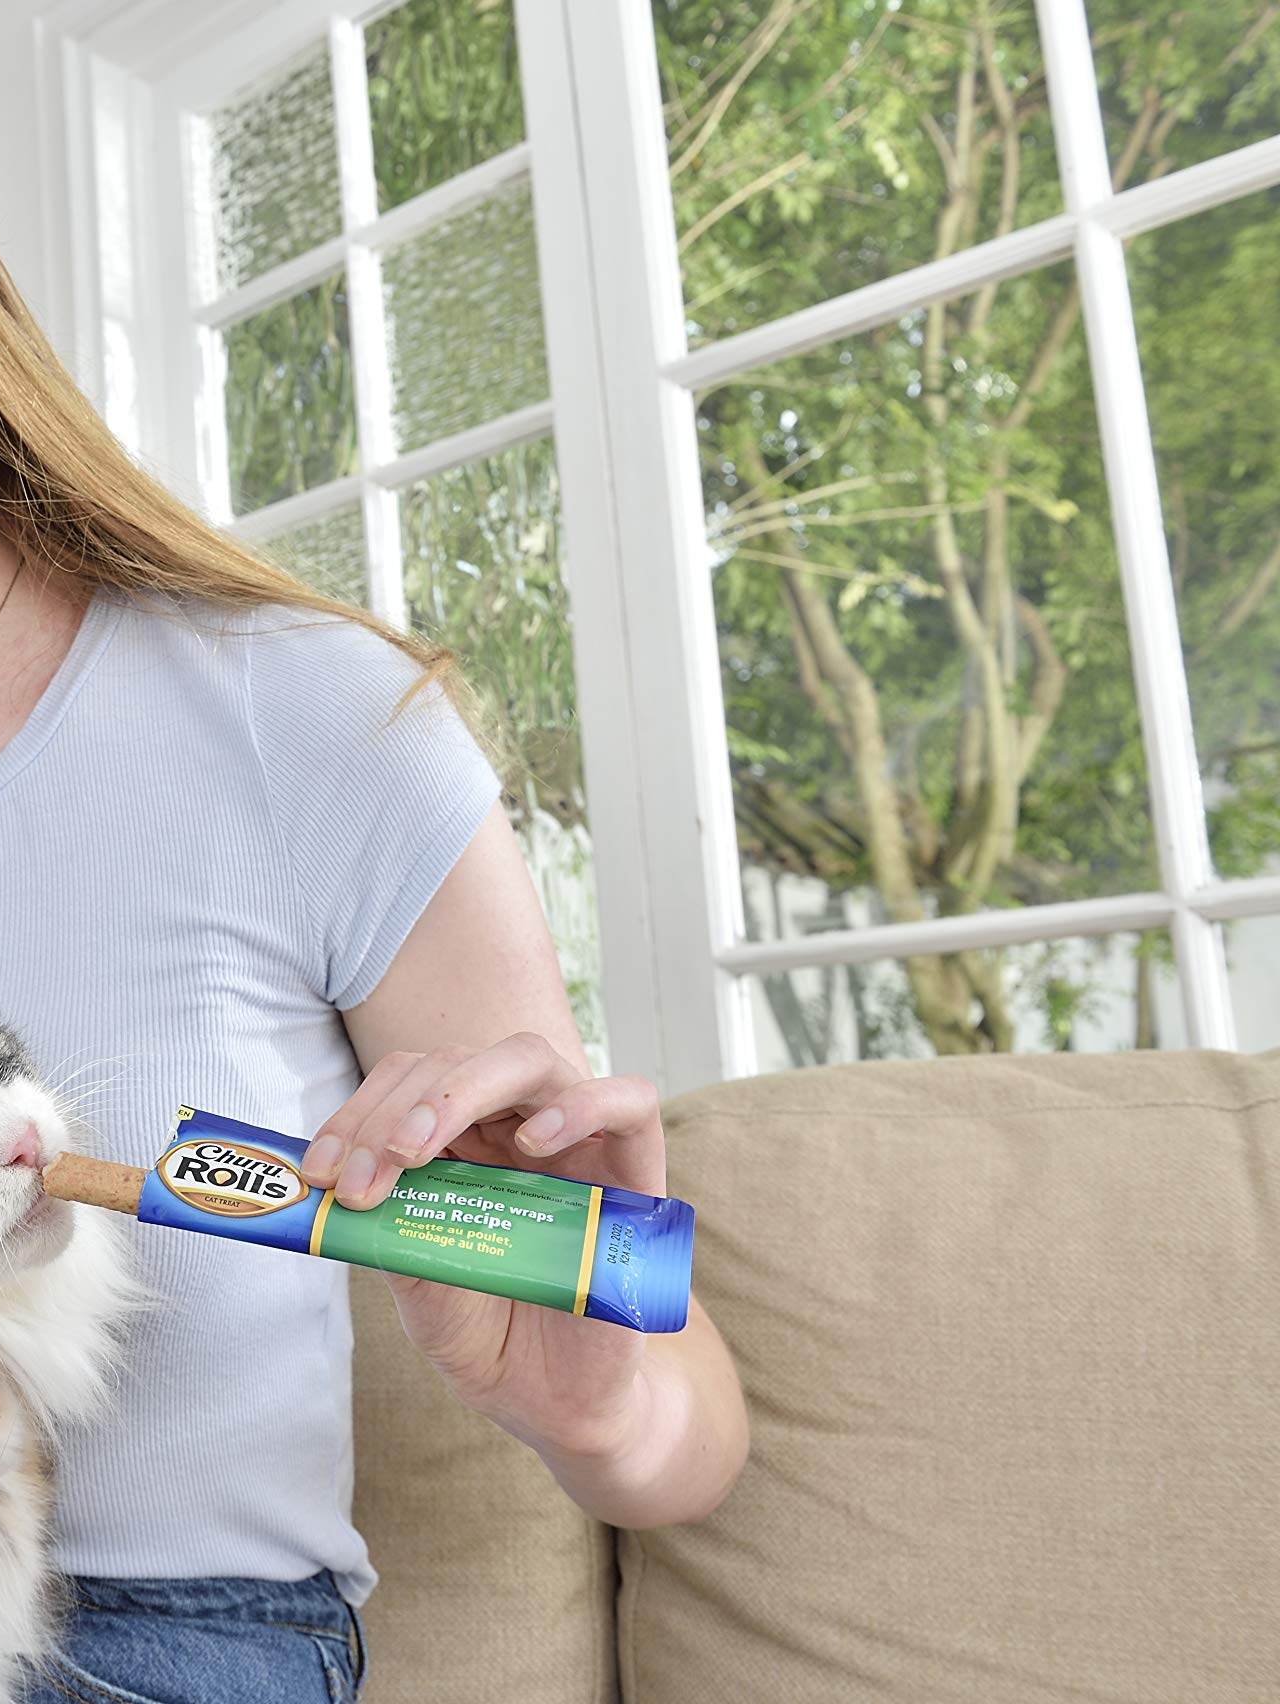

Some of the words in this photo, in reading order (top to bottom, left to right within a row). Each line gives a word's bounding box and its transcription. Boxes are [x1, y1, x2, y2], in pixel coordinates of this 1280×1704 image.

[195, 1144, 285, 1177] Churu
[173, 1156, 288, 1199] Rolls
[444, 1178, 464, 1186] treat
[521, 1191, 563, 1203] individual
[564, 1200, 587, 1208] sale.
[204, 1195, 218, 1203] CAT
[220, 1198, 240, 1208] TREAT
[388, 1186, 439, 1203] icken
[444, 1192, 505, 1212] Recipe
[509, 1206, 554, 1223] wraps
[404, 1204, 446, 1220] Tuna
[450, 1209, 512, 1231] Recipe
[394, 1217, 444, 1232] Recette
[447, 1227, 464, 1236] au
[466, 1230, 513, 1249] poulet,
[398, 1228, 455, 1247] enrobage
[458, 1239, 474, 1250] au
[477, 1241, 505, 1257] thon
[607, 1223, 622, 1264] 04.01.2022
